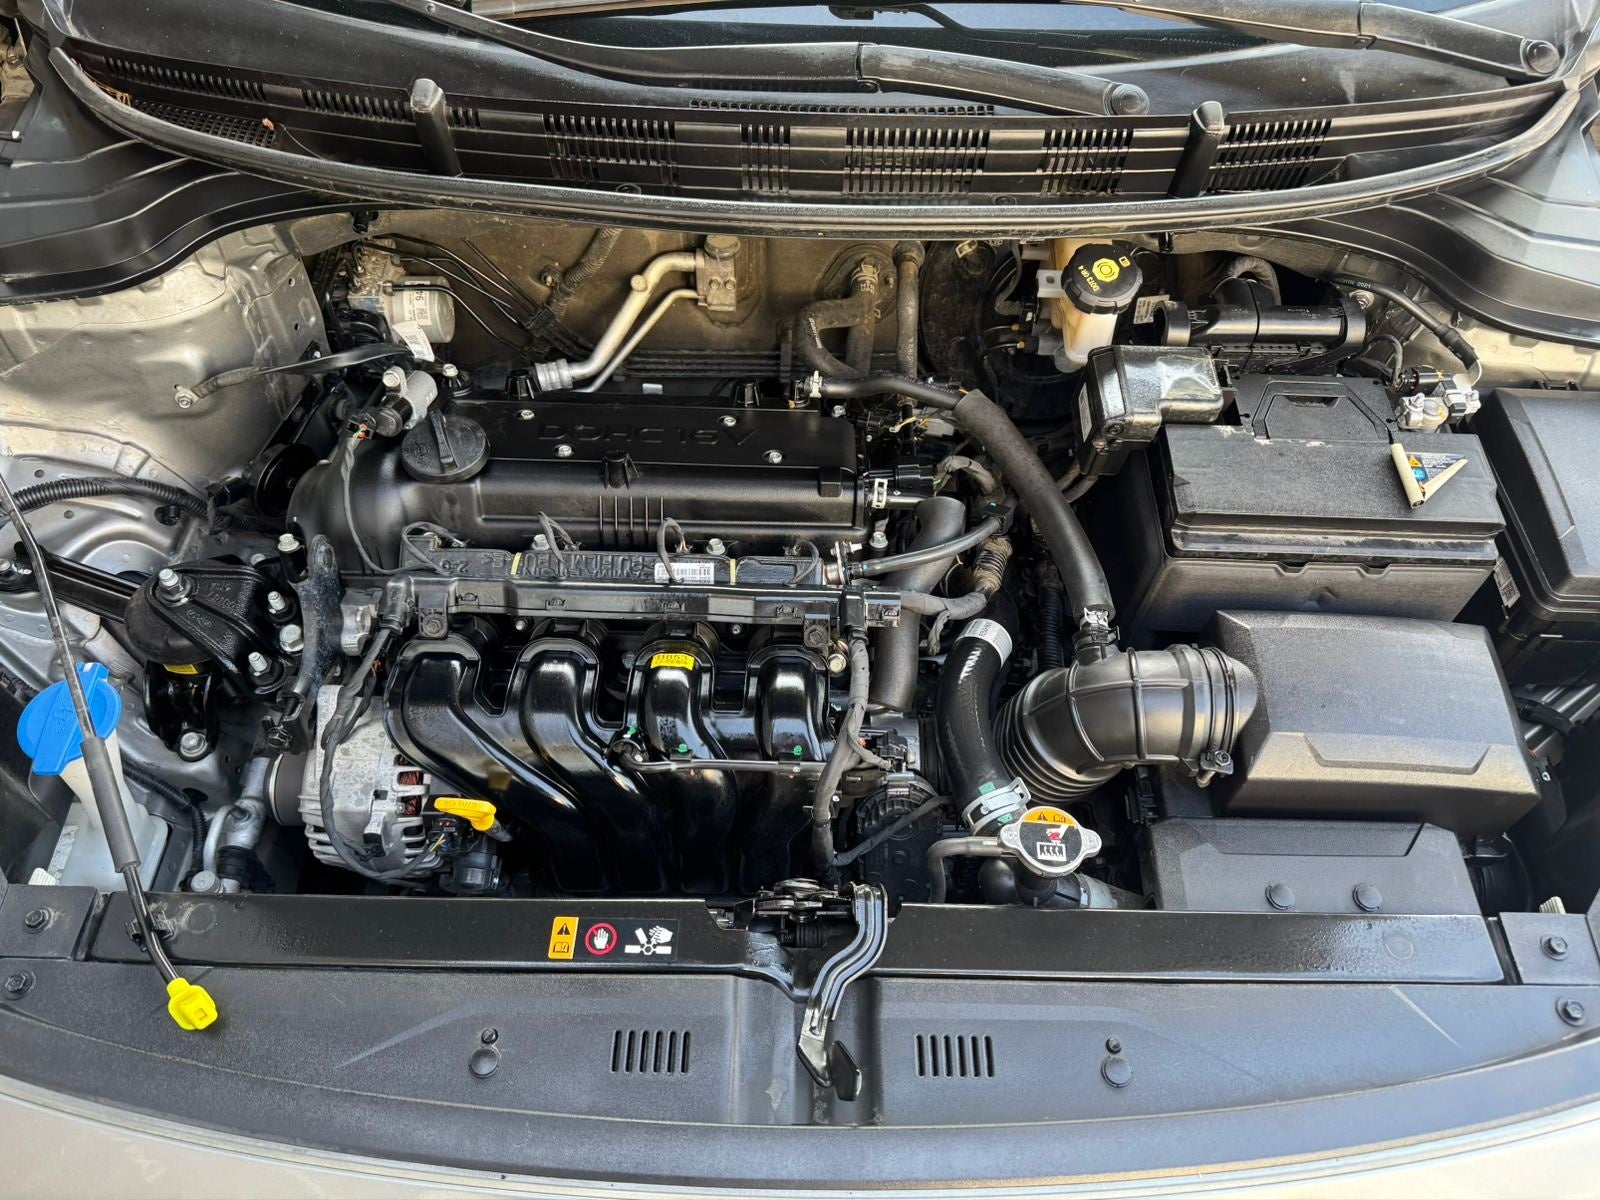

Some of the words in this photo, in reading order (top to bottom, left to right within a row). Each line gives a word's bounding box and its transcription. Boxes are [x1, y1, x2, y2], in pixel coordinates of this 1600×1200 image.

[1080, 269, 1090, 278] OR
[1086, 276, 1100, 292] DOT3
[537, 424, 665, 444] DOHC
[676, 428, 758, 446] 16V
